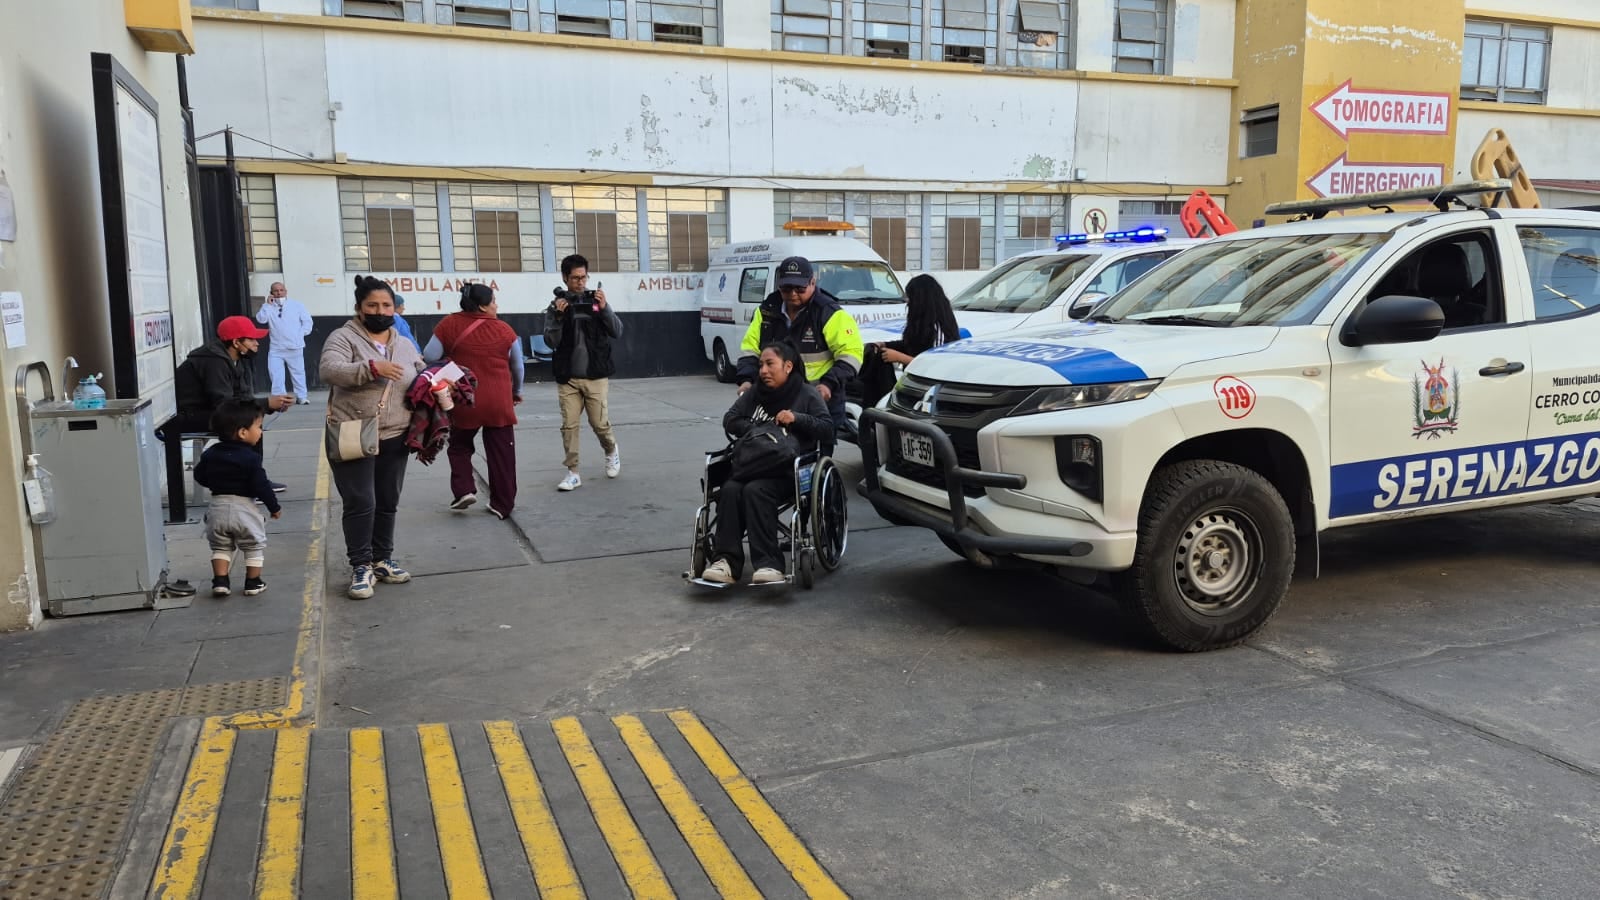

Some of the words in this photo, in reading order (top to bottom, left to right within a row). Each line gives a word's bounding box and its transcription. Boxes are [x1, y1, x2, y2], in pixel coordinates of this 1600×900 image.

[1332, 98, 1443, 125] TOMOGRAFIA
[1329, 172, 1435, 194] EMERGENCIA
[385, 277, 500, 292] MBULANA
[638, 277, 704, 291] AMBULA
[1552, 374, 1600, 387] Municipalida
[1219, 386, 1251, 411] 119
[1535, 391, 1580, 409] CERRO
[1582, 389, 1600, 404] CO
[1373, 436, 1600, 509] SERENAZGO
